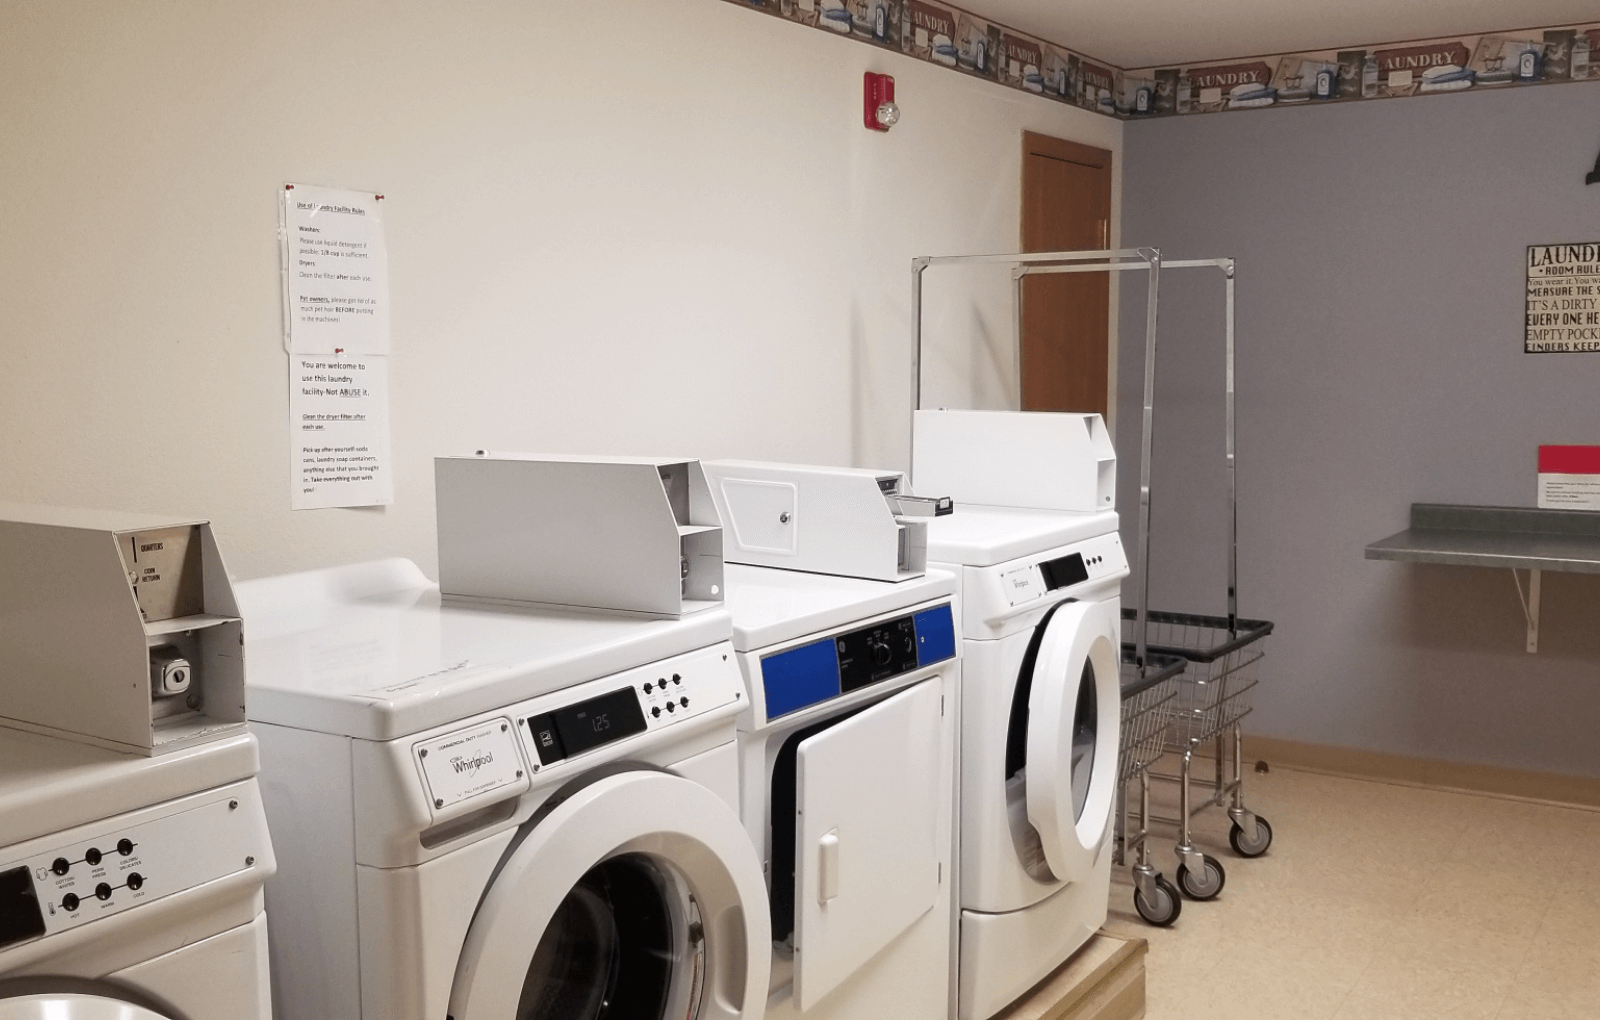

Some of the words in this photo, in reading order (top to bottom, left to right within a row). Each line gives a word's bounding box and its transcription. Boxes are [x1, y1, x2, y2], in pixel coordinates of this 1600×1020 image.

[314, 203, 333, 212] Lundry
[338, 241, 362, 249] detergent
[1545, 265, 1574, 275] ROOM
[1528, 286, 1573, 296] MEASURE
[1576, 286, 1593, 295] THE
[1527, 300, 1548, 310] IT'S
[1551, 300, 1559, 310] A
[1562, 299, 1597, 310] DIRTY
[1527, 313, 1560, 326] EVERY
[1562, 312, 1583, 325] ONE
[1586, 312, 1600, 324] HE
[1527, 329, 1565, 340] EMPTY
[1568, 328, 1600, 340] POCK
[1526, 342, 1570, 351] FINDERS
[1573, 342, 1600, 350] KEEP
[301, 361, 315, 369] You
[327, 362, 358, 370] welcome
[328, 375, 353, 384] laundry
[340, 388, 361, 397] ABUSE
[141, 542, 163, 552] QUARTERS
[438, 740, 464, 751] COMMERCIAL
[452, 751, 494, 773] Whirlpool
